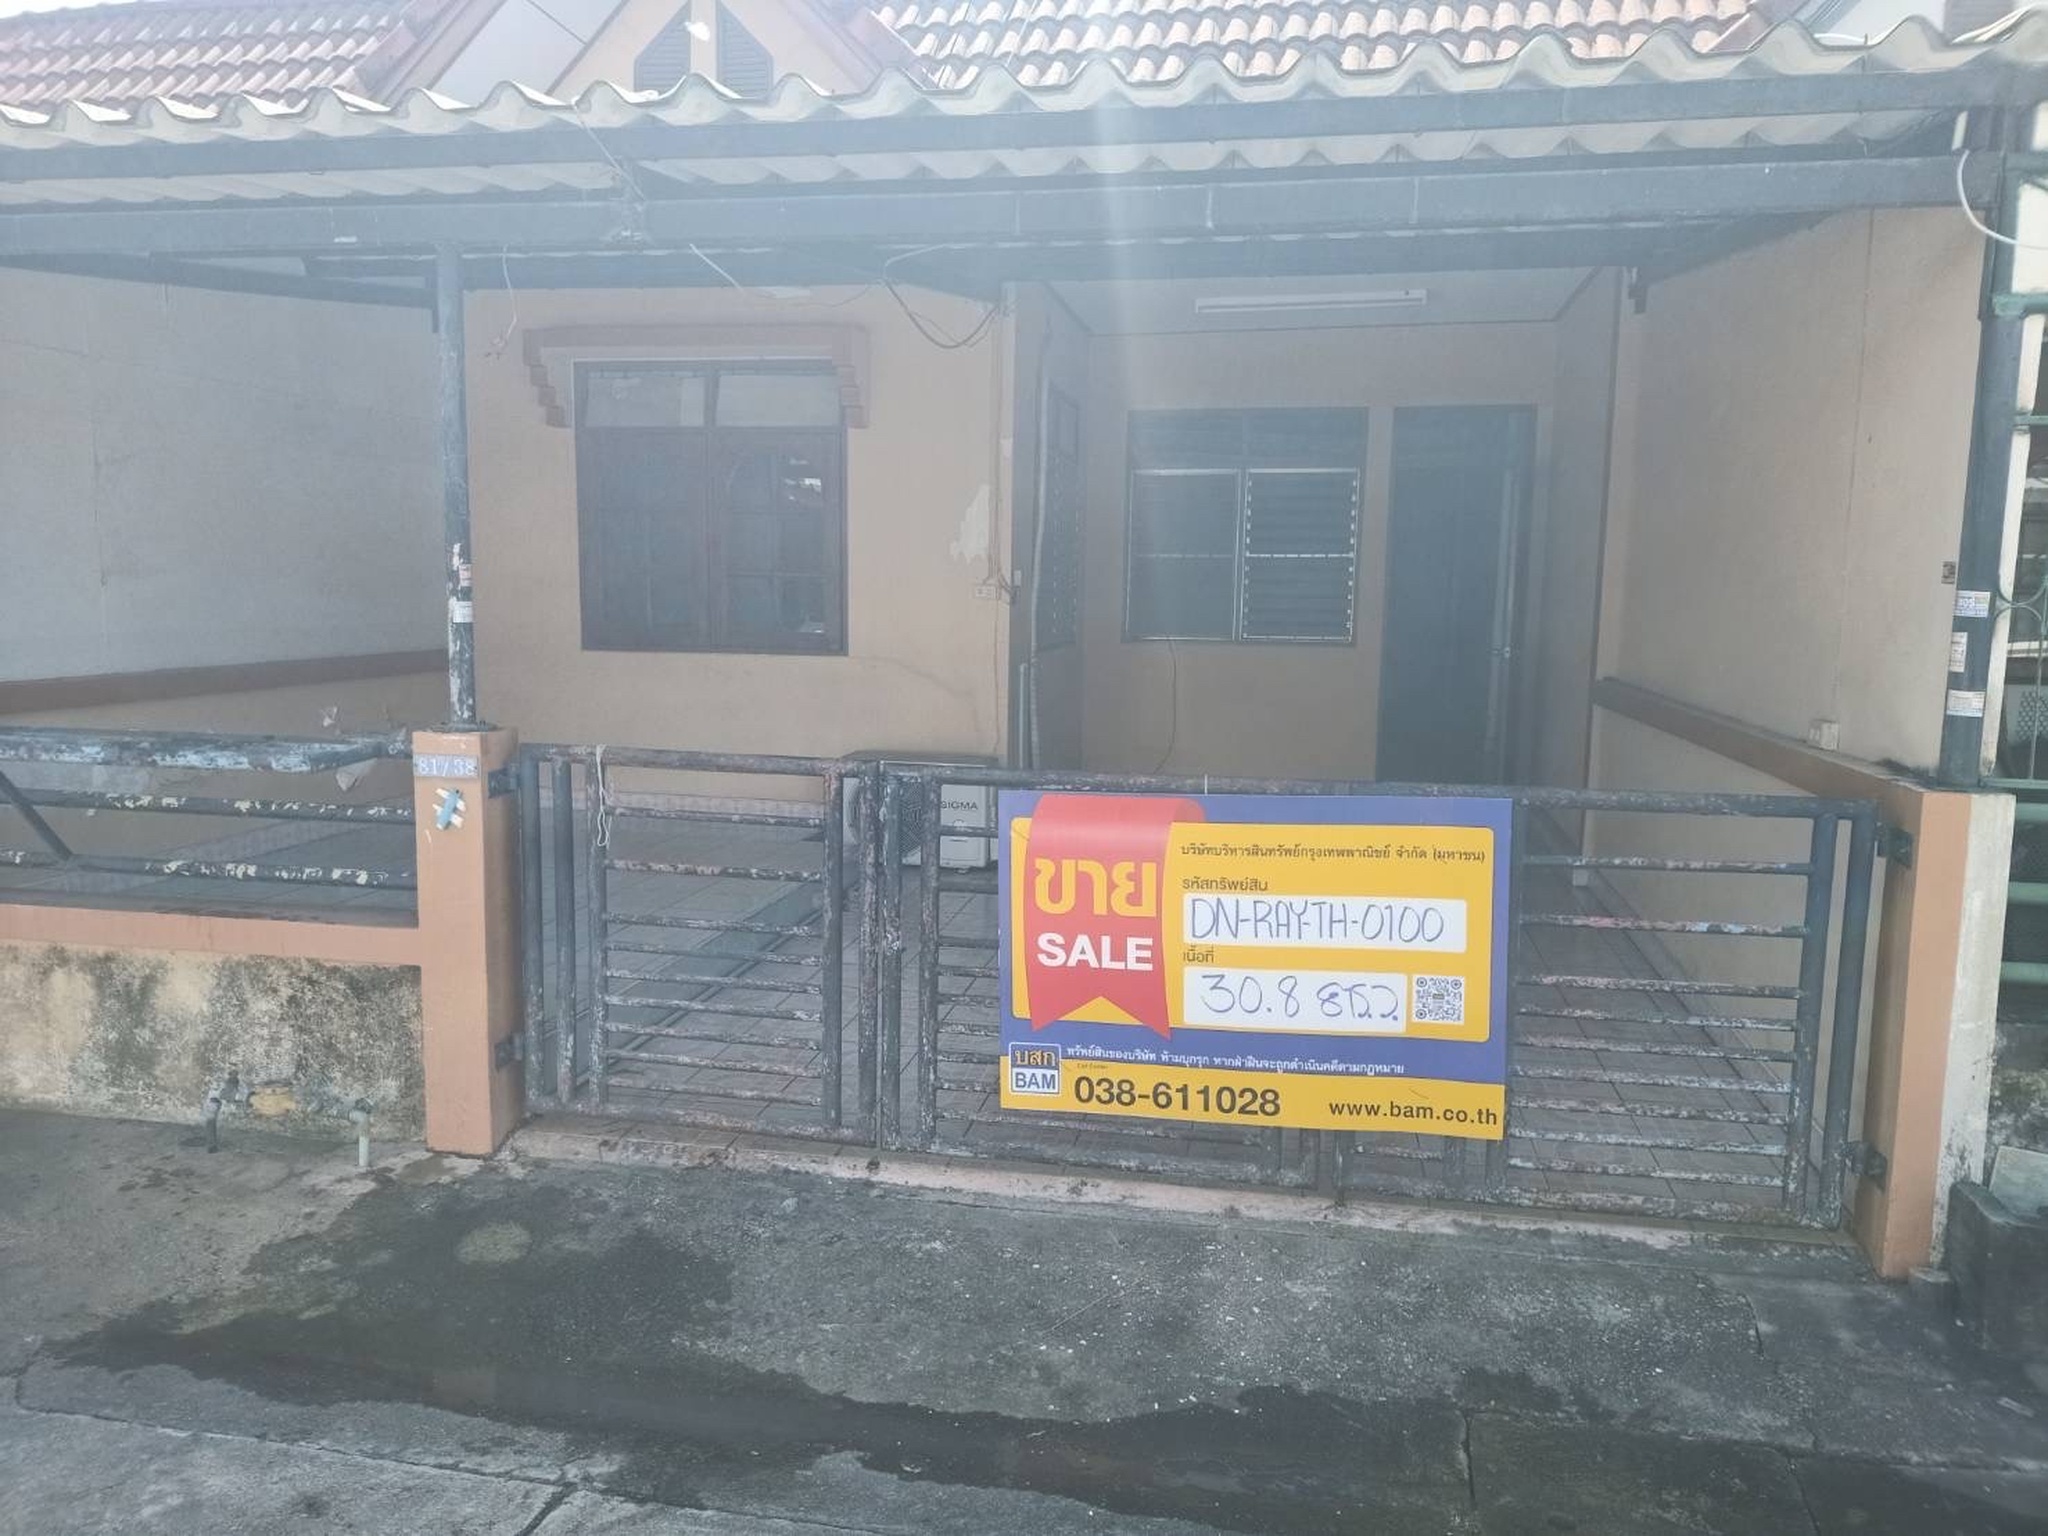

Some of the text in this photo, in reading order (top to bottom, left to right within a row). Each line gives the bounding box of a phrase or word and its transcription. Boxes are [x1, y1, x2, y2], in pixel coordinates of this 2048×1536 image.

[1397, 844, 1427, 858] จำกัด
[1433, 846, 1485, 864] (มหาชน)
[1034, 857, 1157, 918] ขาย
[1182, 876, 1268, 892] รหัสทรัพย์สิน
[1191, 898, 1444, 942] DN-RAY-TH-0100
[1036, 932, 1154, 971] SALE
[1182, 945, 1215, 964] เนื้อที่
[1200, 974, 1300, 1018] 30.8
[1066, 1045, 1157, 1061] ทรัพย์สินของบริษัท
[1160, 1050, 1209, 1067] ห้ามบุกรุก
[1014, 1071, 1056, 1090] BAM
[1074, 1075, 1280, 1117] 038-611028
[1329, 1100, 1497, 1126] www.bam.co.th
